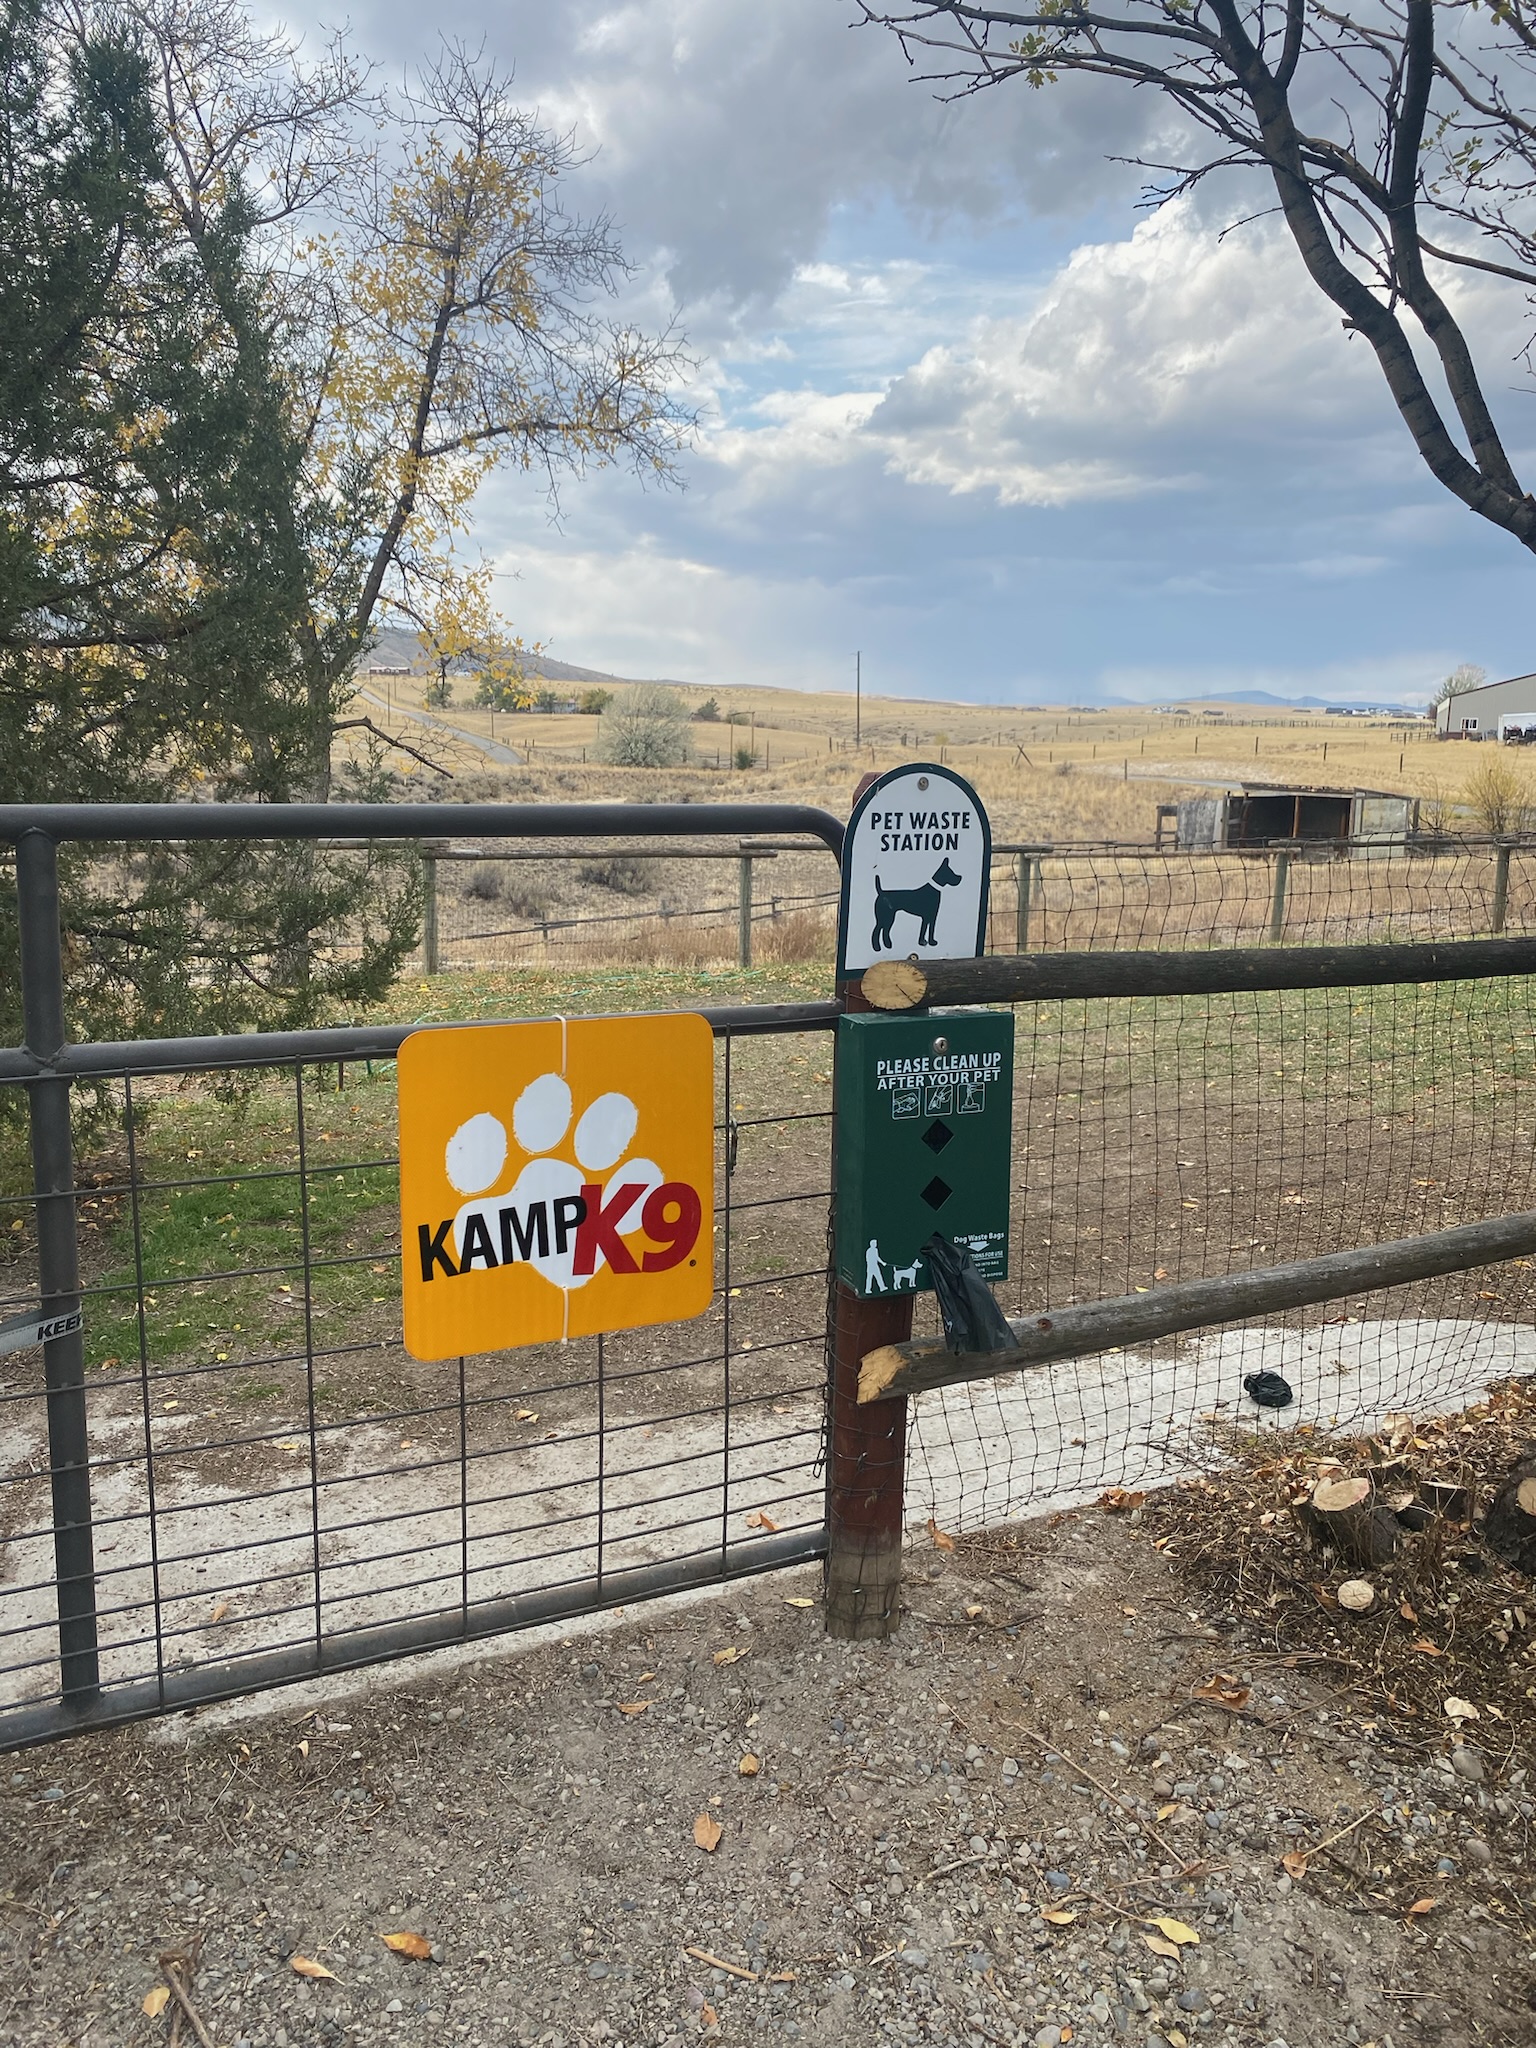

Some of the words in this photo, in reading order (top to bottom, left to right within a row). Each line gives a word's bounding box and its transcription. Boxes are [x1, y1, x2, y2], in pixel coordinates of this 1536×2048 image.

[871, 812, 903, 830] PET
[910, 811, 970, 830] WASTE
[880, 833, 959, 852] STATION
[877, 1056, 930, 1075] PLEASE
[933, 1053, 979, 1071] CLEAN
[983, 1052, 1002, 1067] UP
[877, 1075, 925, 1091] AFTER
[928, 1071, 969, 1086] YOUR
[974, 1069, 1001, 1083] PET
[953, 1236, 968, 1244] Dog
[988, 1232, 1005, 1240] Bags
